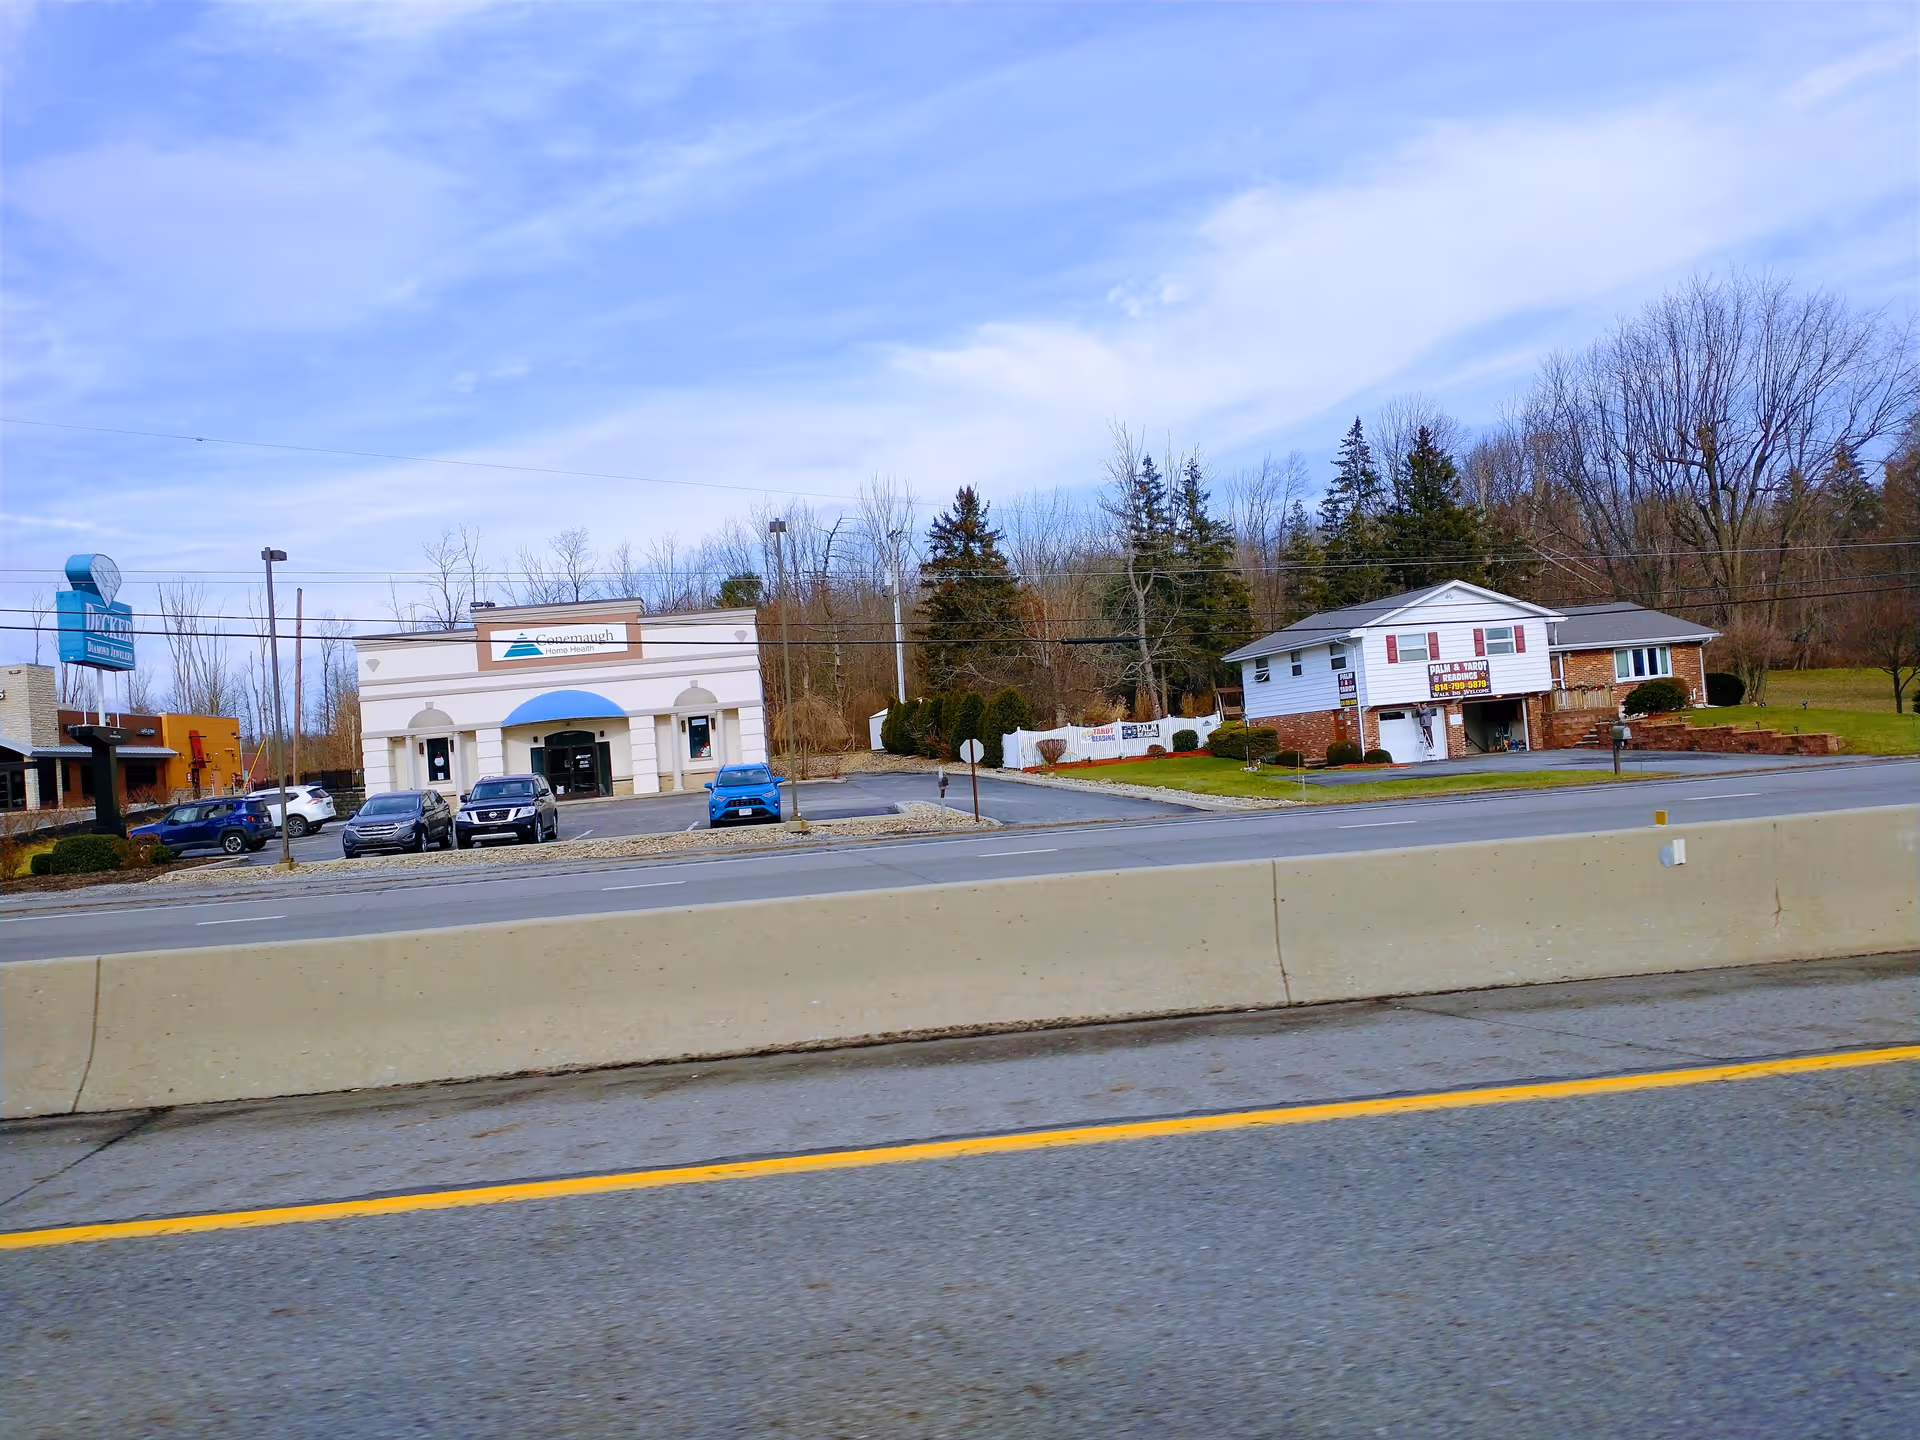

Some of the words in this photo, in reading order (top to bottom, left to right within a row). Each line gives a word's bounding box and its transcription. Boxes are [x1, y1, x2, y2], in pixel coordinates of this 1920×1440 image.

[85, 603, 133, 643] DECKER
[536, 629, 614, 646] Conemaugh
[545, 647, 568, 655] Home
[570, 645, 595, 653] Health
[1430, 664, 1450, 675] PALM
[1453, 663, 1460, 671] &
[1463, 660, 1488, 671] TAROT
[1442, 671, 1478, 682] READINGS
[1092, 734, 1115, 742] READING
